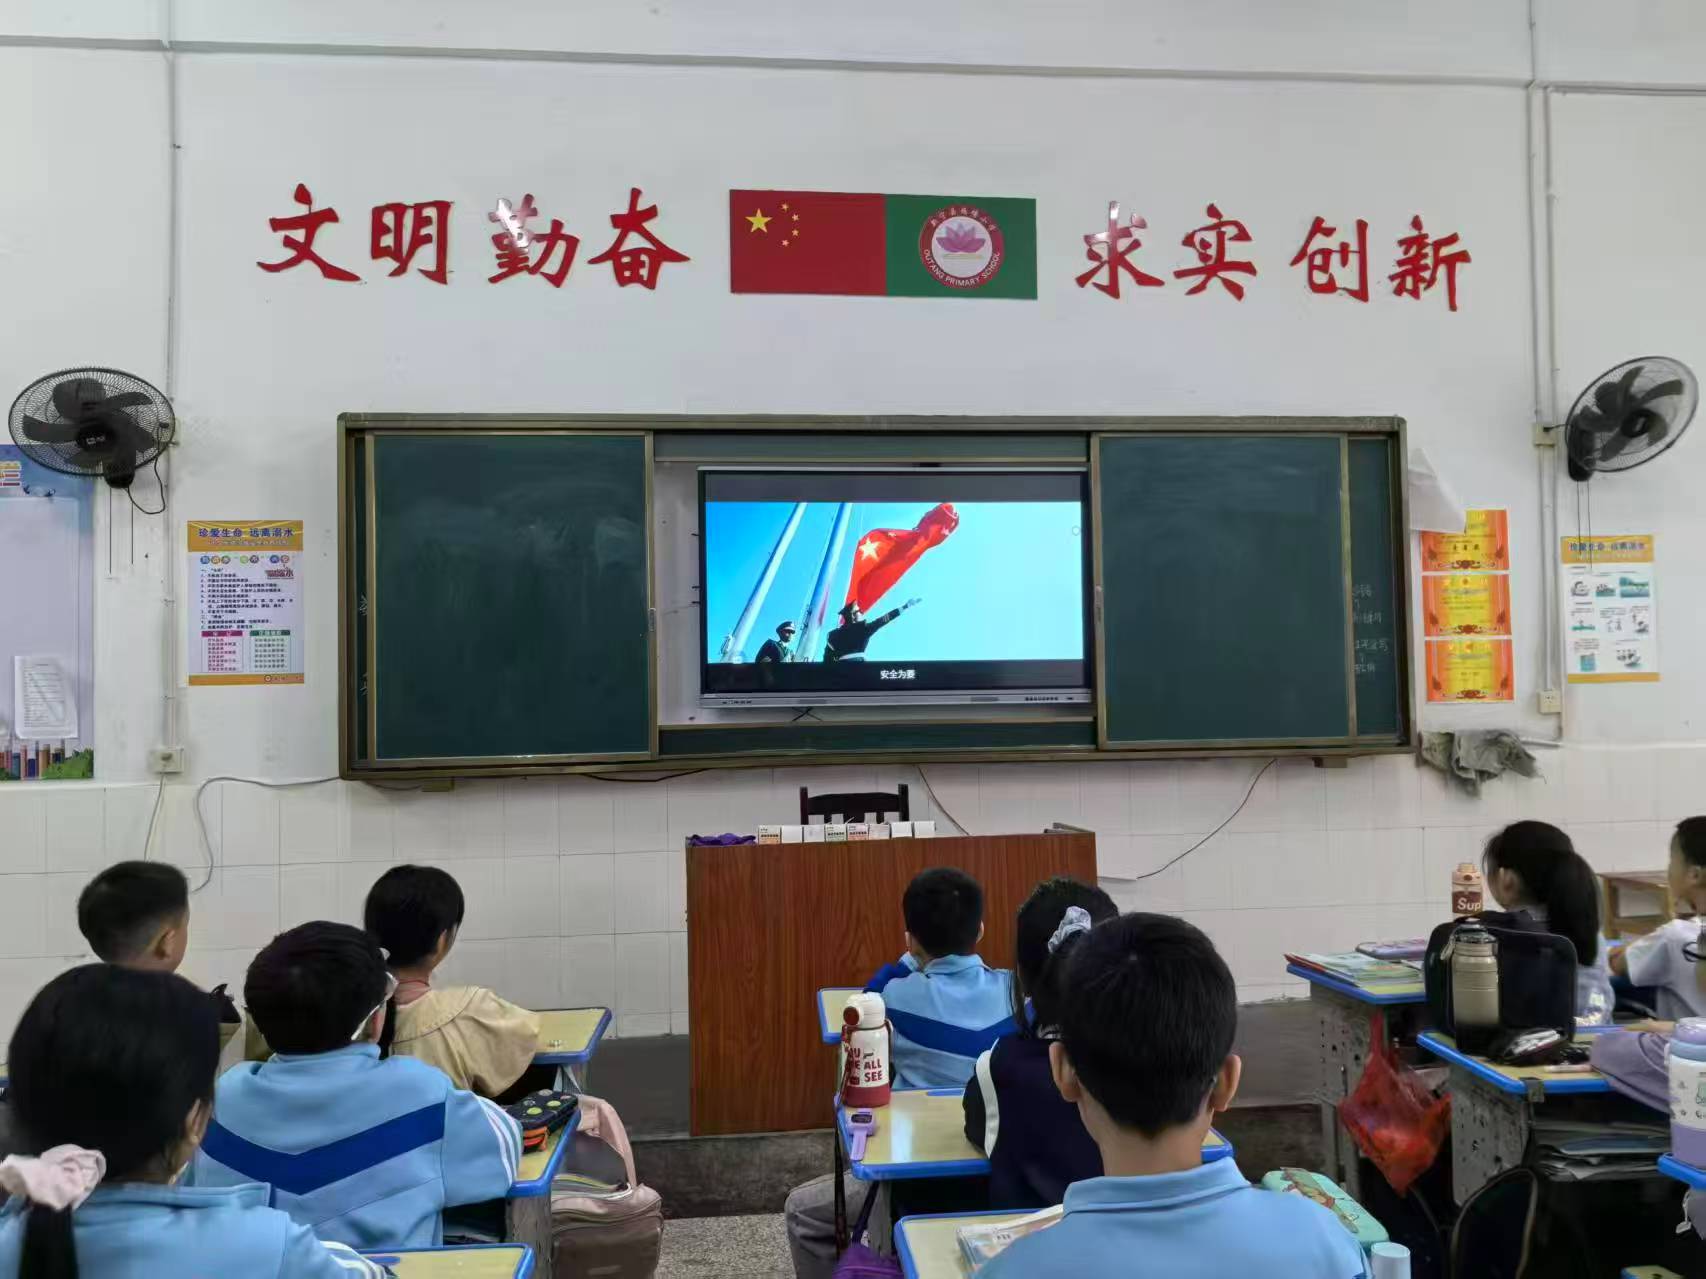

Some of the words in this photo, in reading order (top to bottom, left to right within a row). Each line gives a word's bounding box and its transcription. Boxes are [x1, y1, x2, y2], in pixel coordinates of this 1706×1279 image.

[256, 183, 454, 285] 文明
[487, 187, 691, 290] 勤奋
[1075, 200, 1257, 302] 求实
[1290, 214, 1472, 313] 创新
[945, 276, 980, 287] PRIMARY
[981, 252, 1001, 279] SCHOOL
[880, 669, 916, 680] 安全为要
[863, 1058, 882, 1070] ALL
[864, 1070, 883, 1083] SEE
